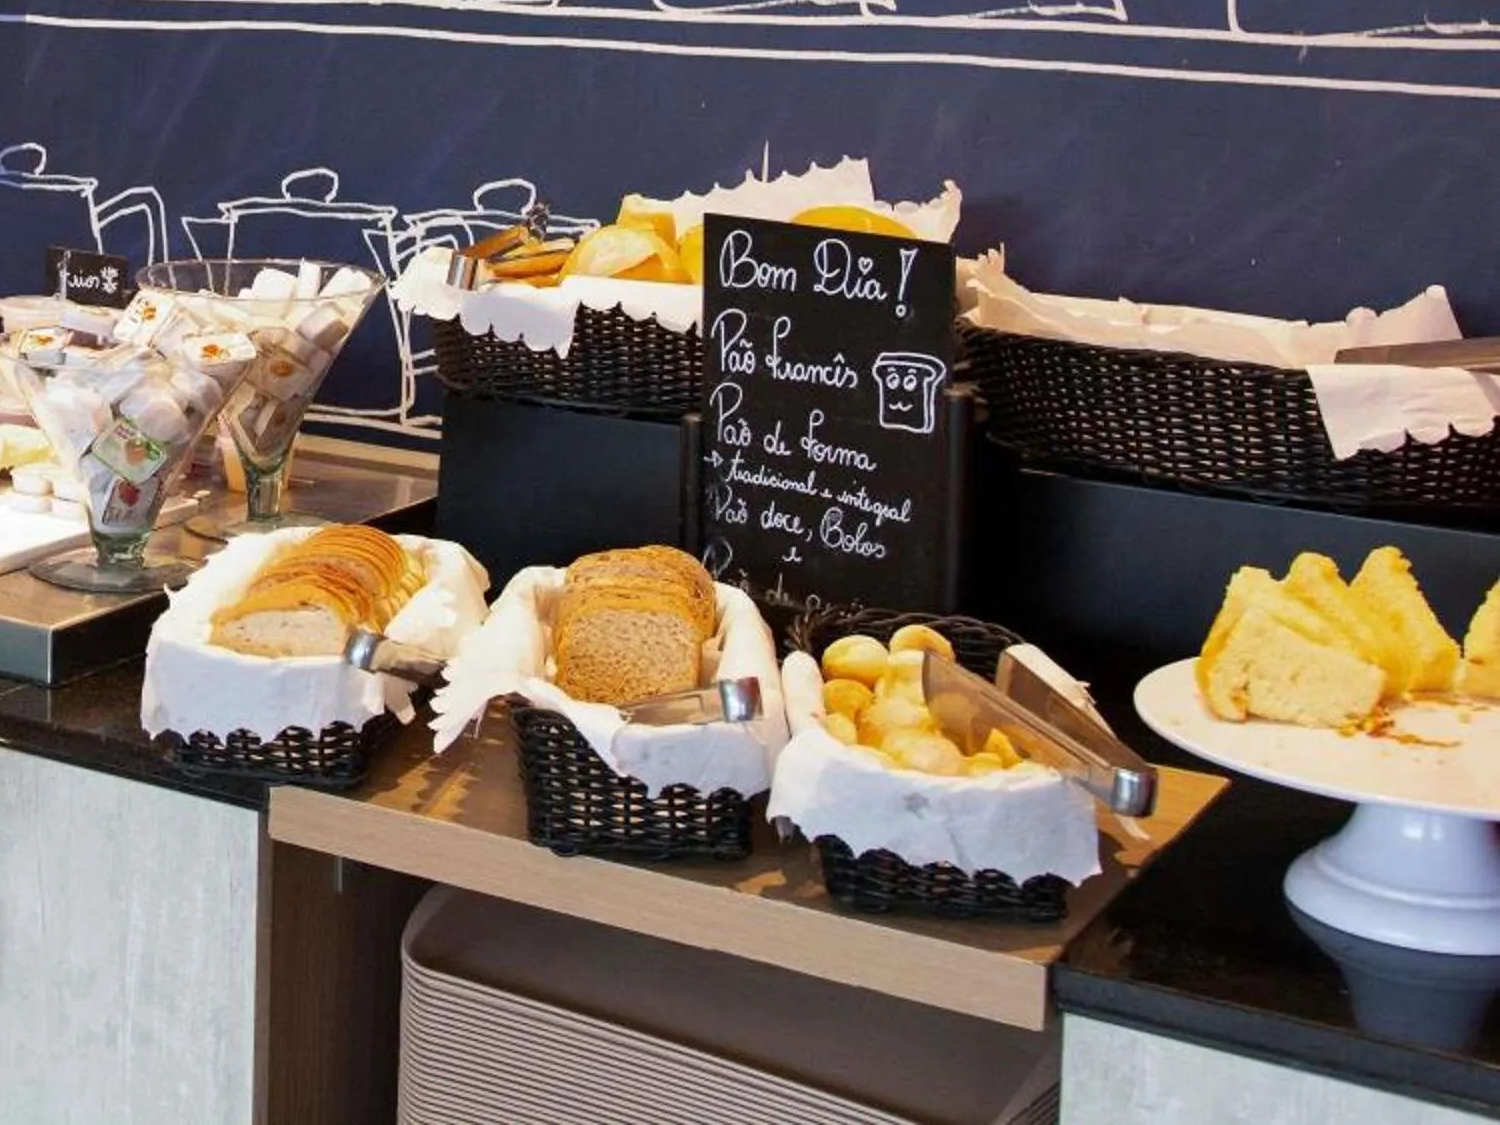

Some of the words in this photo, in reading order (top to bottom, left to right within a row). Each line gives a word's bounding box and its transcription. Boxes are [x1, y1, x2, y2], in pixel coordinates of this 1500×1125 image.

[719, 230, 797, 291] Bom
[710, 308, 756, 374] Pão
[709, 382, 751, 447] Pão
[763, 420, 792, 455] de
